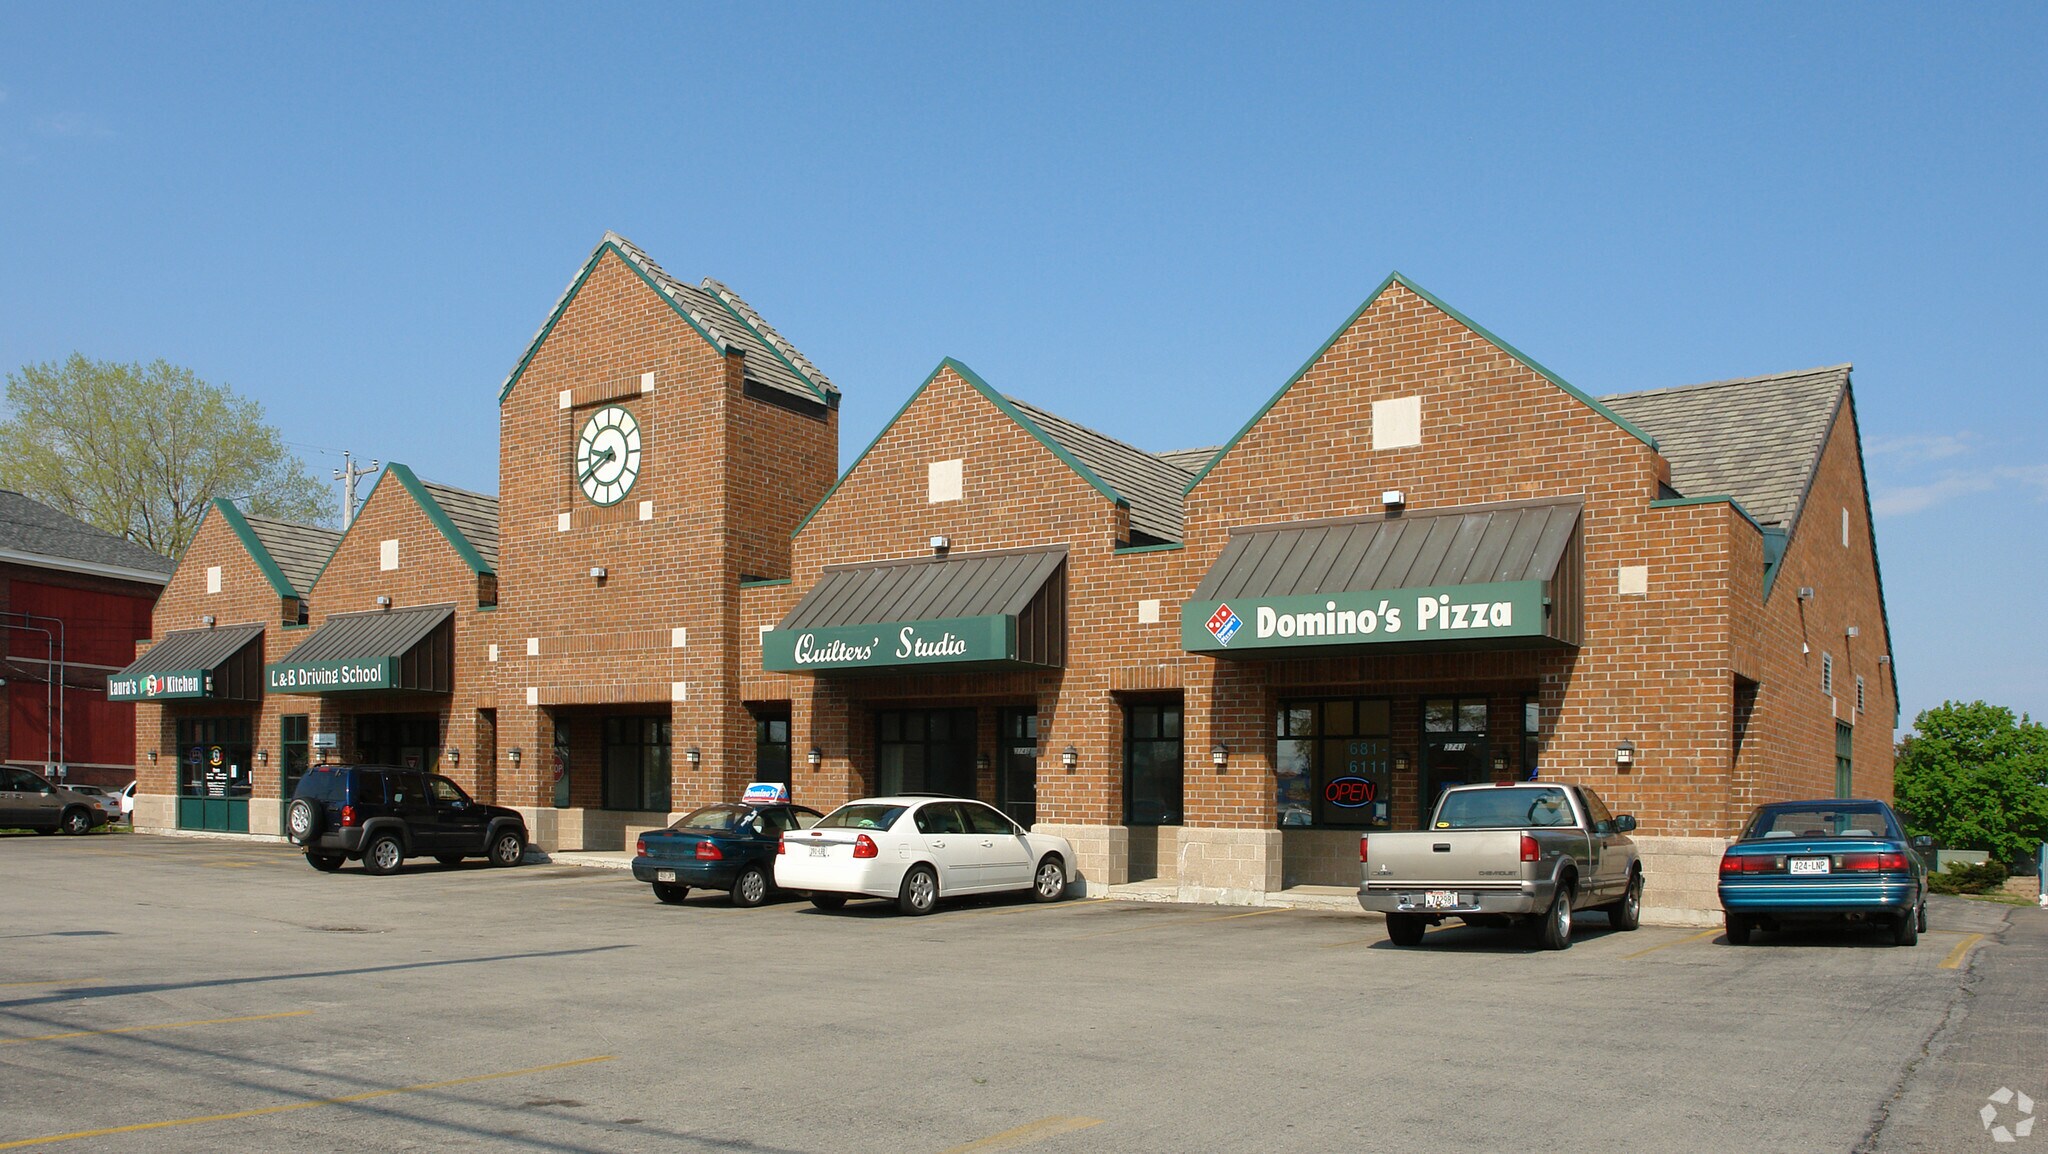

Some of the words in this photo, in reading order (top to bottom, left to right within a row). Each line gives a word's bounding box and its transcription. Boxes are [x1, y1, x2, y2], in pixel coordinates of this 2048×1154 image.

[1256, 599, 1402, 638] Domino's
[1417, 594, 1513, 632] Pizza
[793, 633, 880, 664] Quilters'
[895, 626, 967, 659] Studio
[298, 667, 339, 686] Driving
[341, 663, 382, 684] School
[109, 678, 137, 696] Laura's
[166, 675, 199, 693] Kitchen
[554, 764, 563, 773] OP
[1349, 760, 1387, 774] 6111
[745, 788, 777, 798] Domino's
[1325, 783, 1375, 802] OPEN
[1794, 860, 1825, 871] 424-LNP
